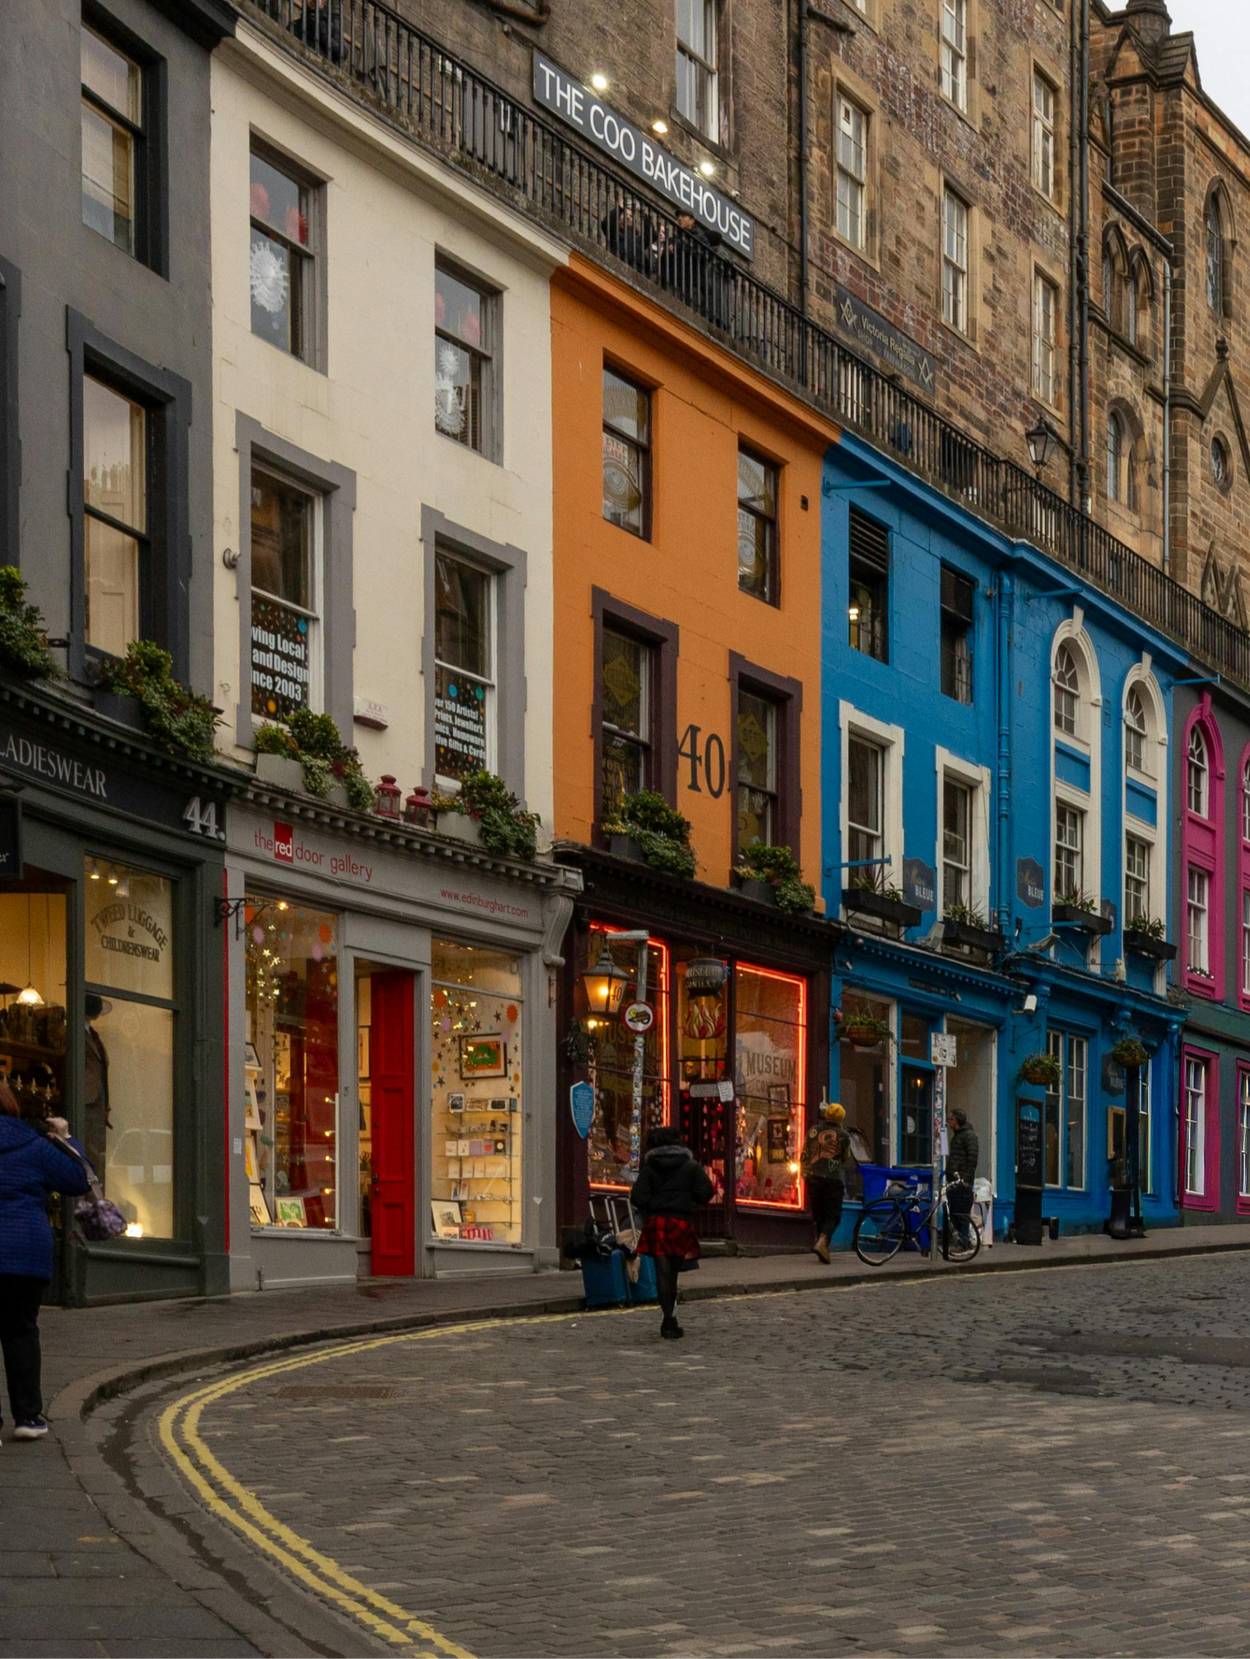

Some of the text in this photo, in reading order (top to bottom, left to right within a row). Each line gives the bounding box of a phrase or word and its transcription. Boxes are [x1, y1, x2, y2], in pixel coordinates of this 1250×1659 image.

[539, 62, 751, 251] THE COO BAKEHOUSE
[861, 314, 889, 346] Victoria
[251, 626, 305, 661] ving Local
[252, 648, 273, 669] and
[274, 675, 302, 702] 2003
[445, 699, 456, 712] 150
[0, 733, 108, 798] ADIESWEAR
[678, 723, 726, 800] 40
[254, 828, 373, 883] the red door gallery
[440, 888, 529, 919] www.edinburghart.com
[914, 884, 934, 902] BLEUE
[1027, 884, 1044, 901] BLEUE
[90, 902, 168, 952] TWEED LUGGAGE
[100, 934, 160, 963] CHILDRENSWEAR
[611, 984, 622, 1002] 40
[746, 1051, 797, 1085] MUSEUM
